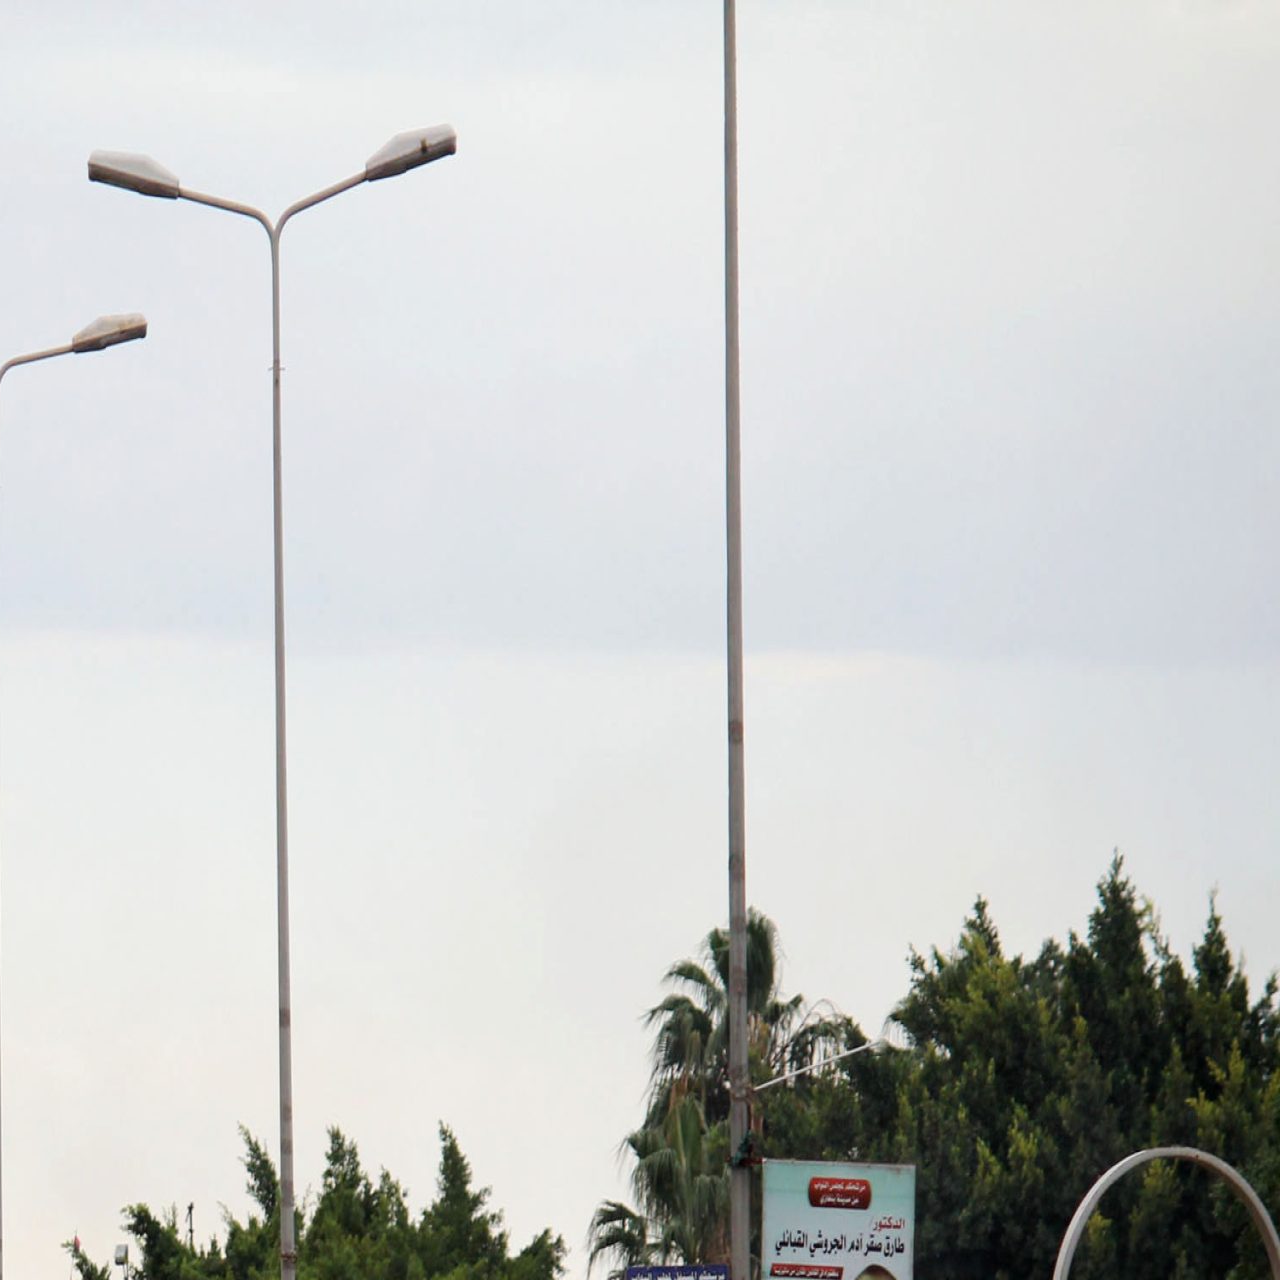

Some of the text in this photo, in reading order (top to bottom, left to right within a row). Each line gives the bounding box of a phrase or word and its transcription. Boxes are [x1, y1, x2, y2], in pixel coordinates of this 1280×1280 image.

[809, 1230, 847, 1258] الجروشي
[864, 1234, 882, 1257] صقر
[883, 1236, 905, 1257] طارق
